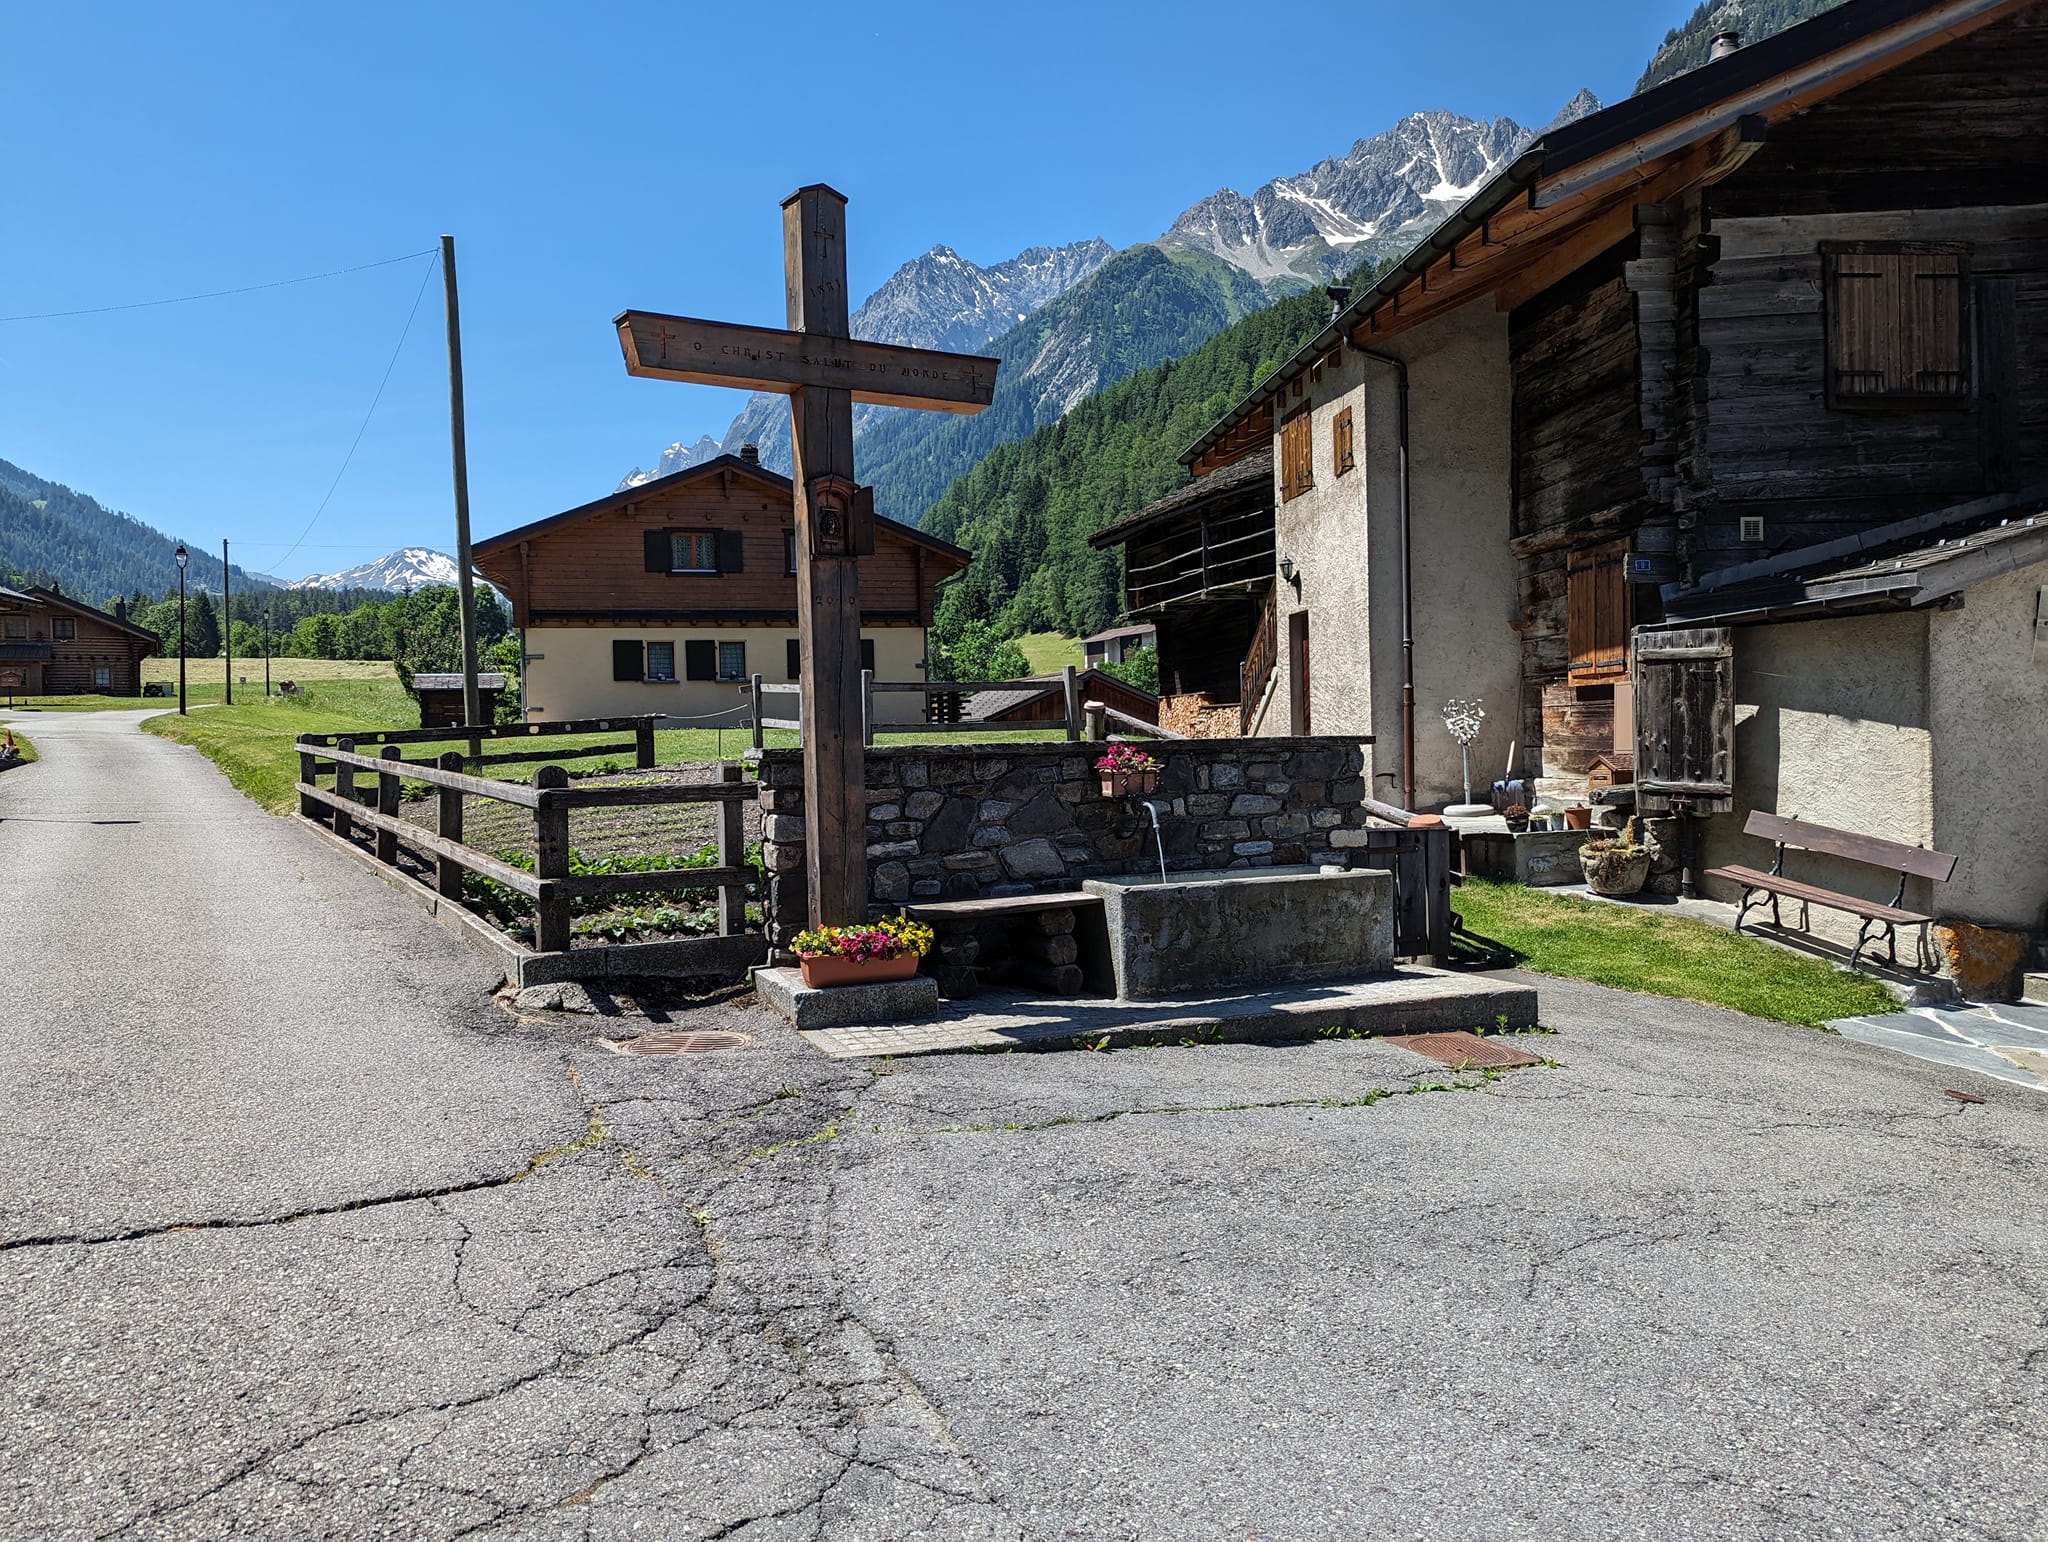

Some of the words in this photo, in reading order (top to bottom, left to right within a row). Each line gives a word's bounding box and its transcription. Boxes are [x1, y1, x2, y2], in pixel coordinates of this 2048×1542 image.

[722, 345, 785, 361] CHRIST
[801, 354, 852, 369] SALUT
[869, 362, 887, 374] DU
[901, 367, 950, 381] MONDE
